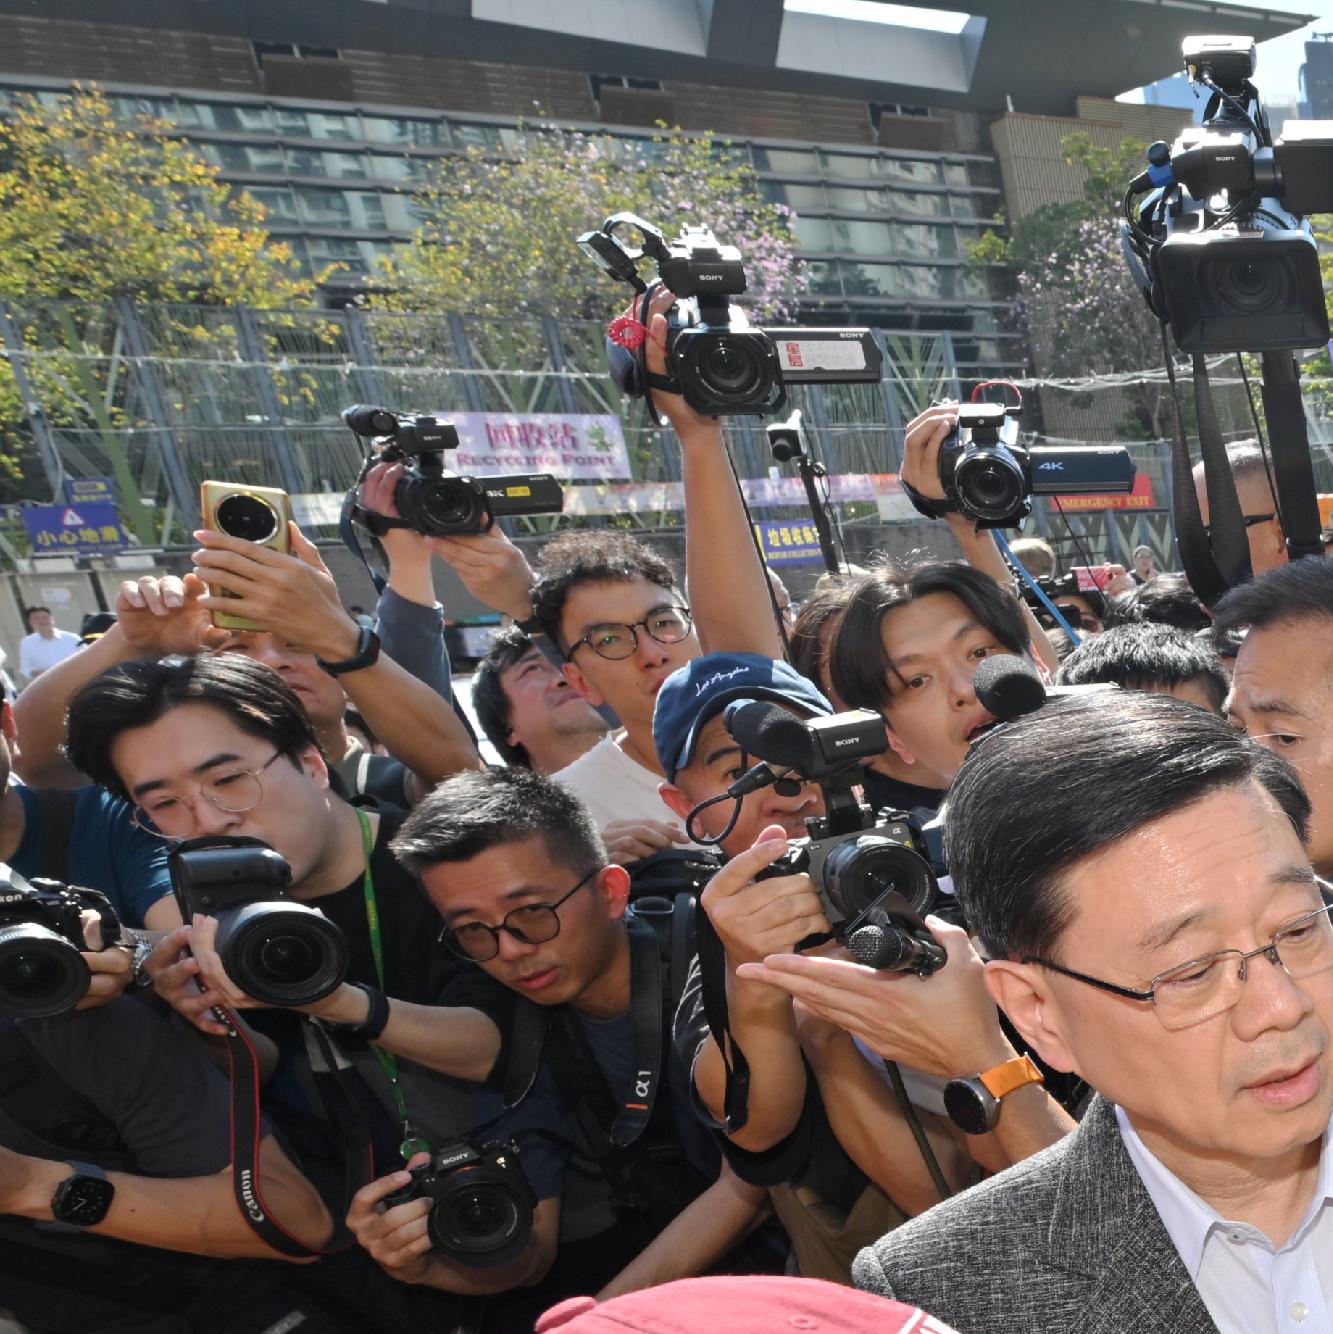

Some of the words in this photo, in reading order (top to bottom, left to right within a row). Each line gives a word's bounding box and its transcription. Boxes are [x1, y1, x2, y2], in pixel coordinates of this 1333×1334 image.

[486, 422, 580, 450] 回收站
[457, 453, 555, 466] RECYCLING
[562, 453, 615, 466] POINT
[1038, 461, 1065, 471] 4K
[1127, 496, 1149, 507] EXIT
[835, 737, 860, 747] SONY
[0, 894, 22, 902] kon
[442, 1152, 469, 1165] SONY
[241, 1169, 265, 1222] Canon
